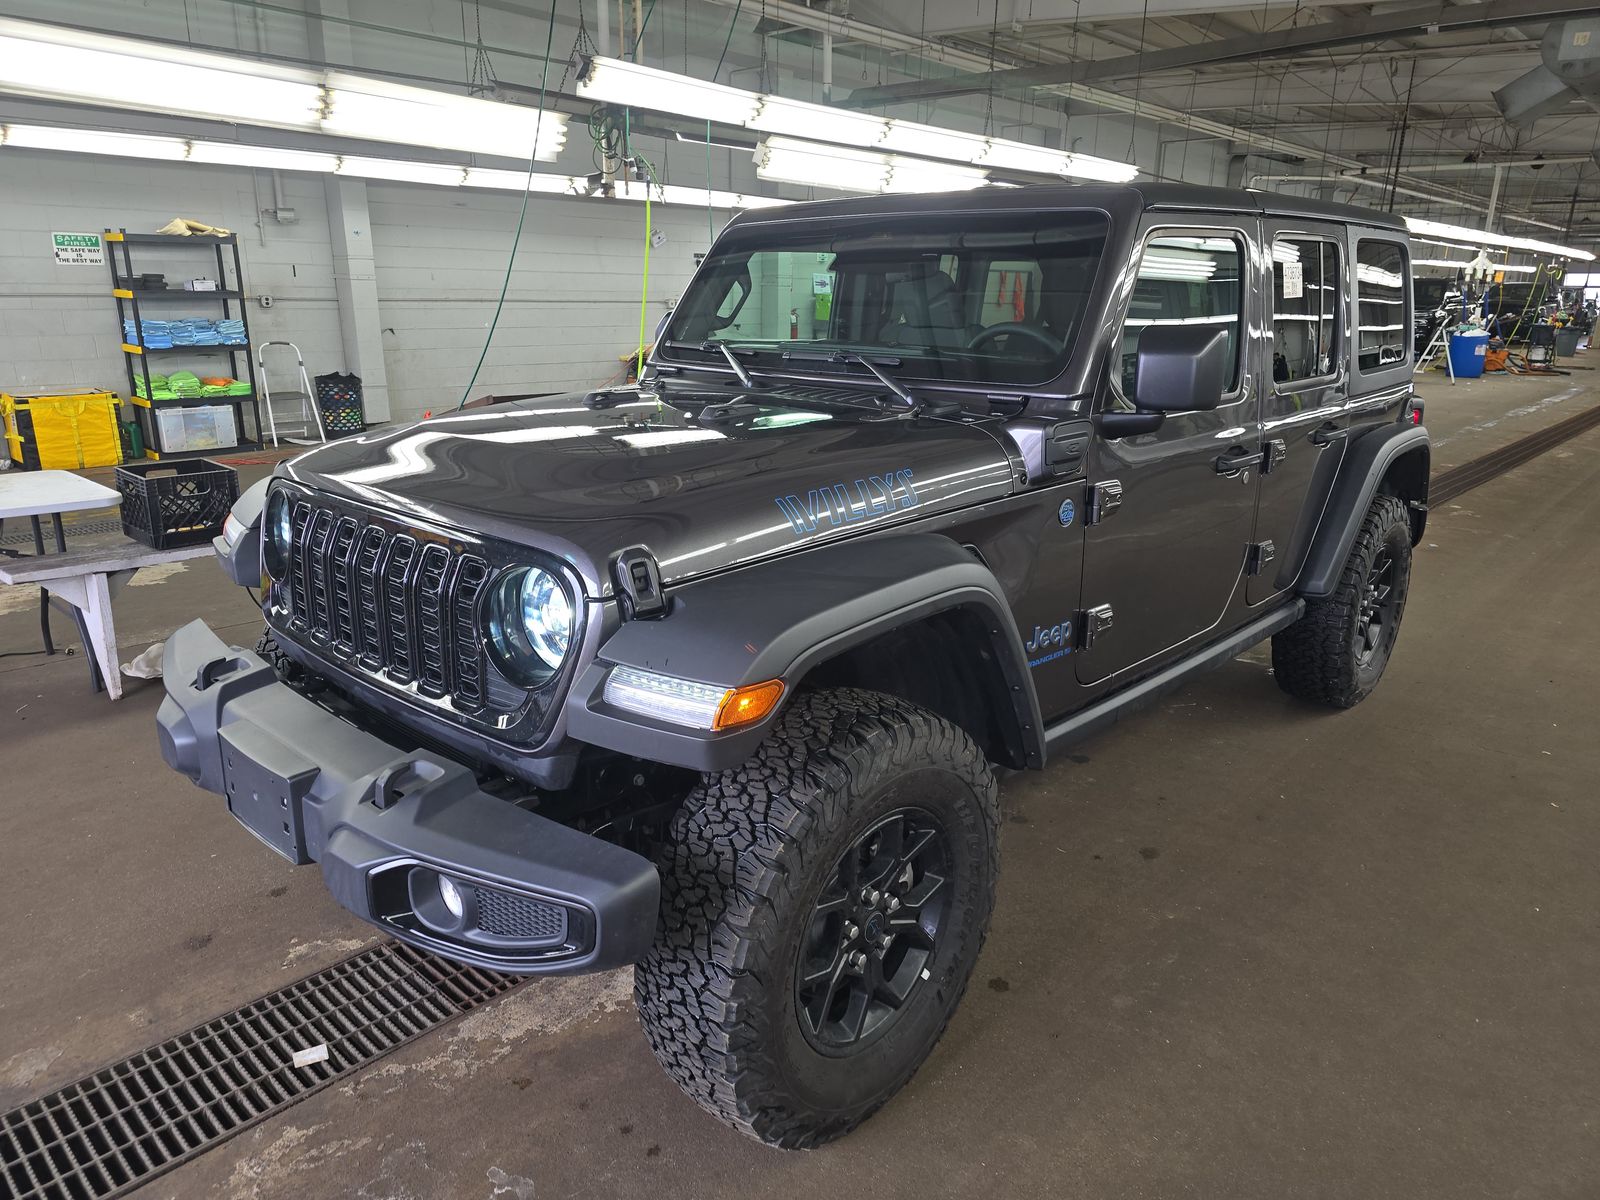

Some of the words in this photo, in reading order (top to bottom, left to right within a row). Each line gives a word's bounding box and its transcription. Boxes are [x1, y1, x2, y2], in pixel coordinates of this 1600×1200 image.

[56, 235, 96, 243] SAFETY
[775, 468, 918, 535] WILLYS
[1026, 620, 1073, 653] Jeep
